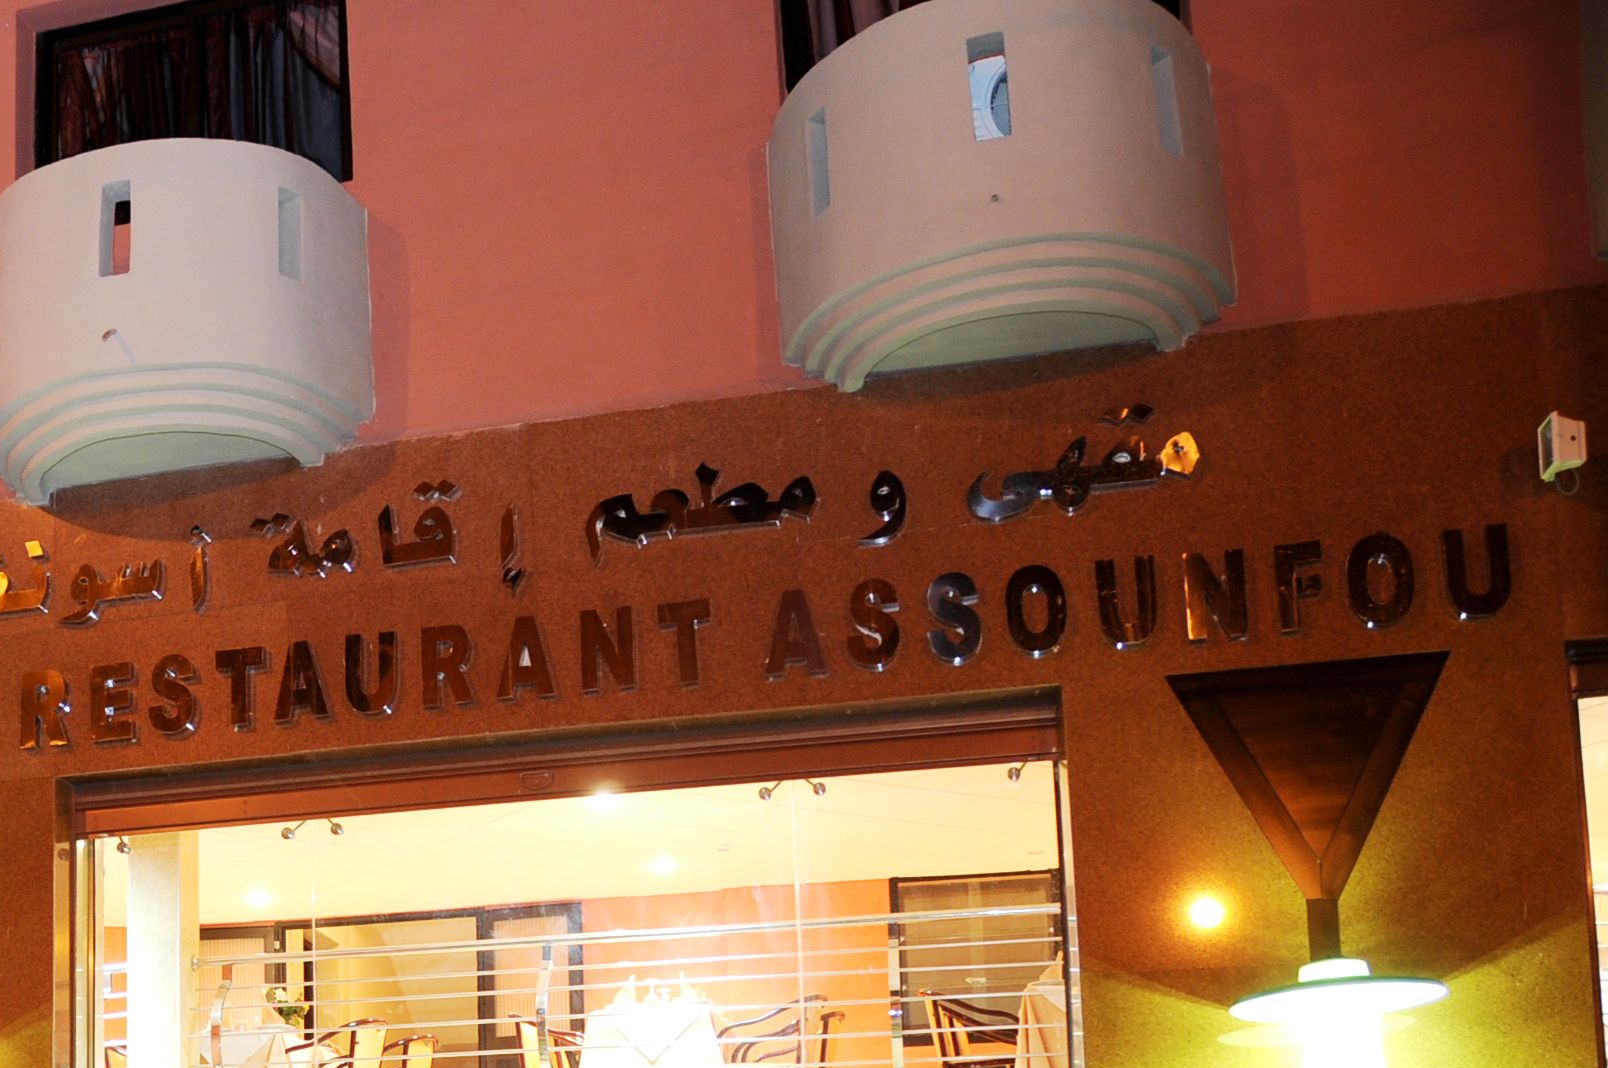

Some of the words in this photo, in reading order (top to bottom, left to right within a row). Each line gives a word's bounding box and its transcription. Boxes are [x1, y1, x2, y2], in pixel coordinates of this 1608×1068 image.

[249, 479, 526, 598] إقامة
[585, 462, 819, 568] مطعم
[857, 470, 907, 547] و
[19, 599, 713, 751] RESTAURANT
[763, 523, 1514, 681] ASSOUNFOU
